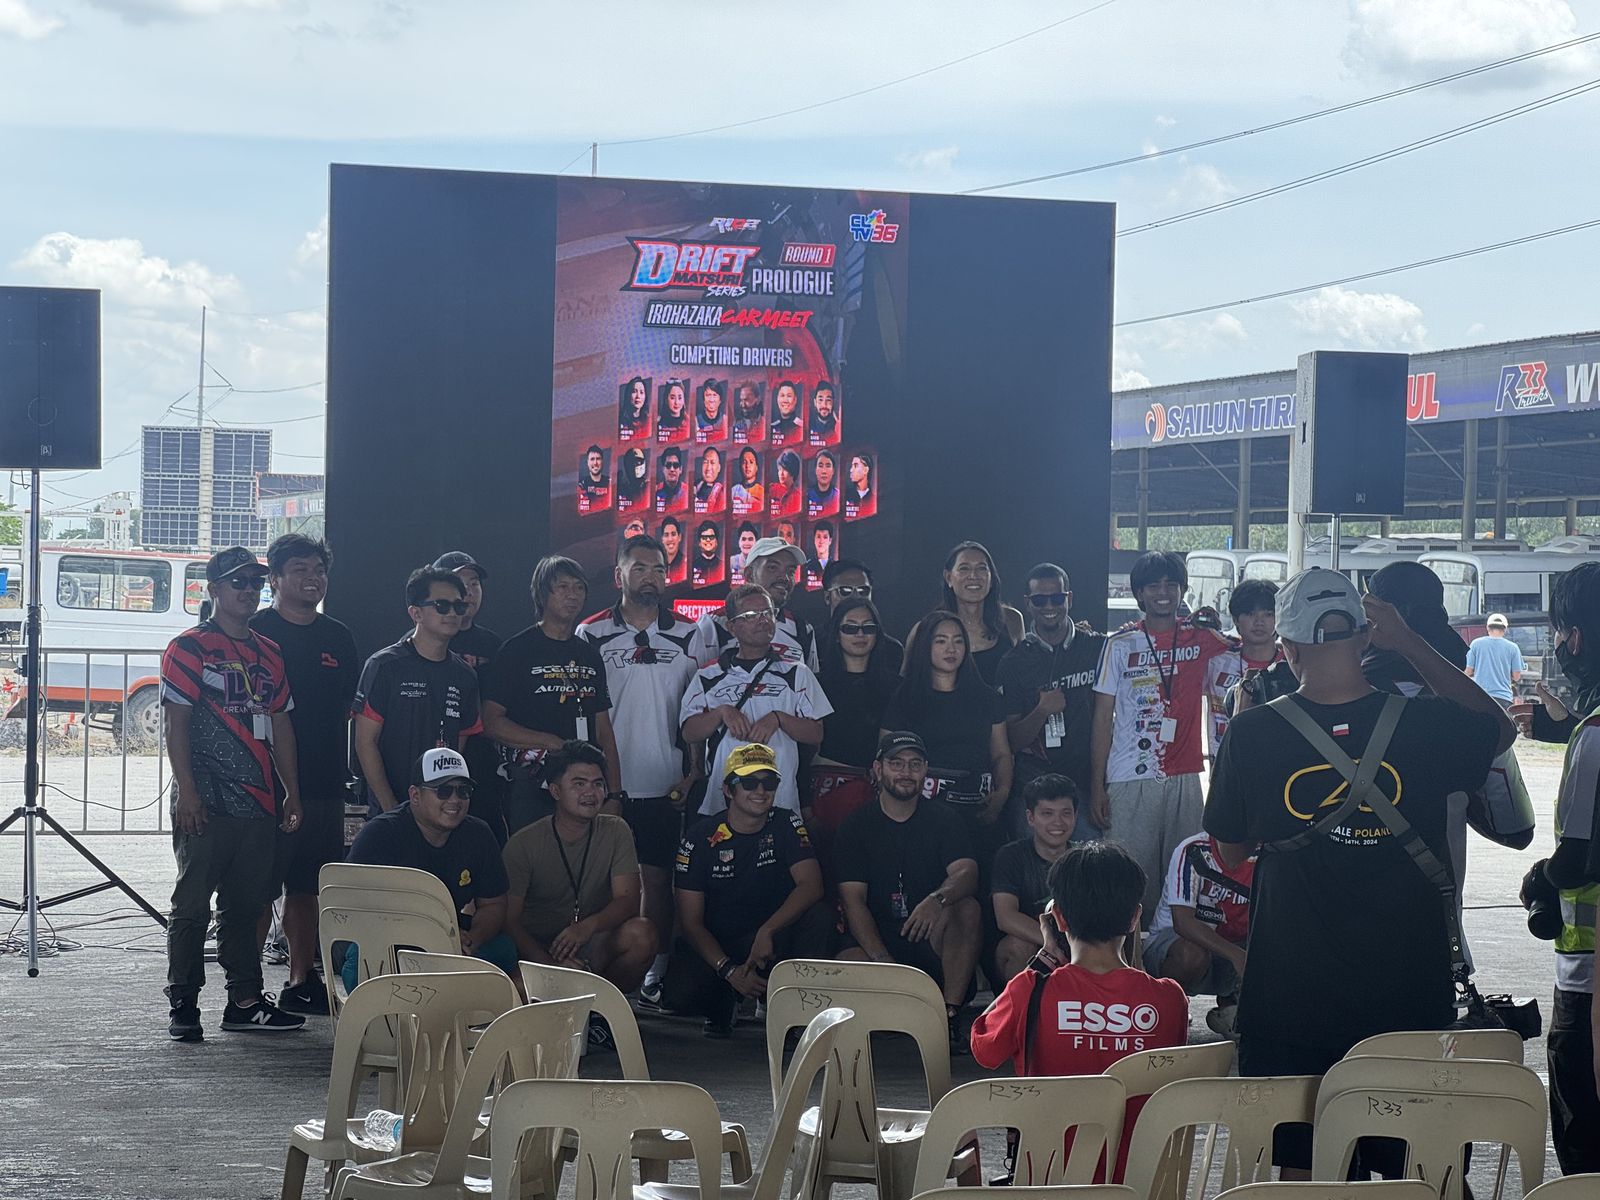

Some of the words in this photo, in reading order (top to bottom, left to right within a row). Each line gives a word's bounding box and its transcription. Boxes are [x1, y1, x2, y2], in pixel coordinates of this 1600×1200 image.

[635, 242, 759, 287] DRIFT
[784, 245, 824, 263] ROUND
[825, 247, 831, 264] 1
[673, 272, 741, 286] MATSURI
[752, 268, 834, 295] PROLOGUE
[706, 286, 747, 297] SERIES
[647, 303, 723, 326] IROHAZAKA
[671, 345, 740, 366] COMPETING
[742, 347, 793, 367] DRIVERS
[1167, 399, 1246, 438] SAILUN
[1057, 1000, 1160, 1034] ESSO
[1073, 1036, 1145, 1051] FILMS
[1367, 1096, 1402, 1117] R33
